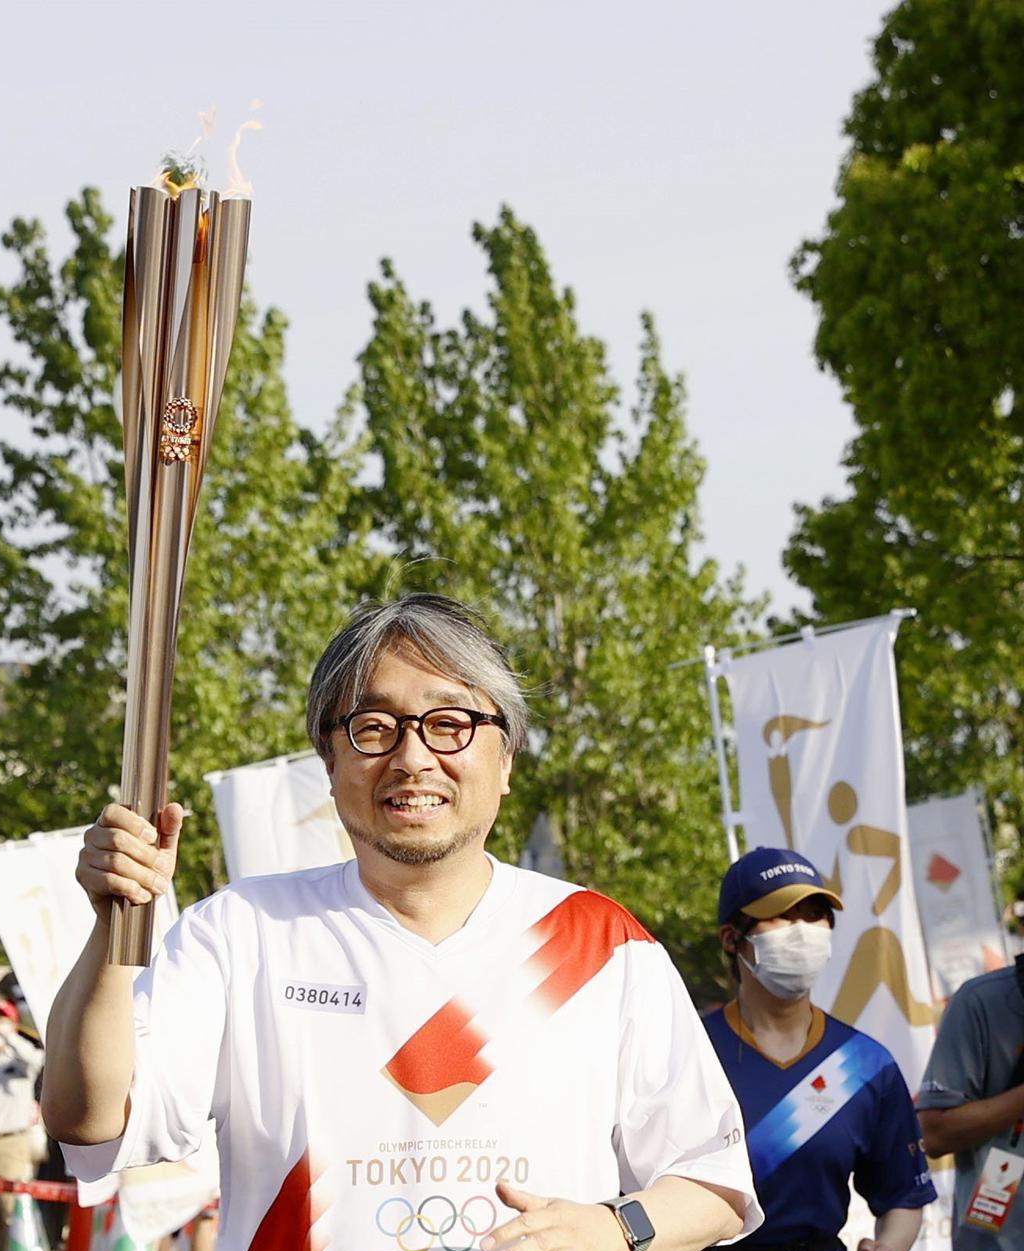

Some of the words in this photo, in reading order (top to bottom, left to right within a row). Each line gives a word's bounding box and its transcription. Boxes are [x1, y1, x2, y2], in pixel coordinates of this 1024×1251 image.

[759, 863, 794, 880] TOKYO
[284, 985, 362, 1007] 0380414
[378, 1140, 424, 1153] OLYMPIC
[427, 1139, 462, 1151] TORCH
[464, 1139, 499, 1150] RELAY
[346, 1155, 448, 1186] TOKYO
[456, 1155, 530, 1184] 2020
